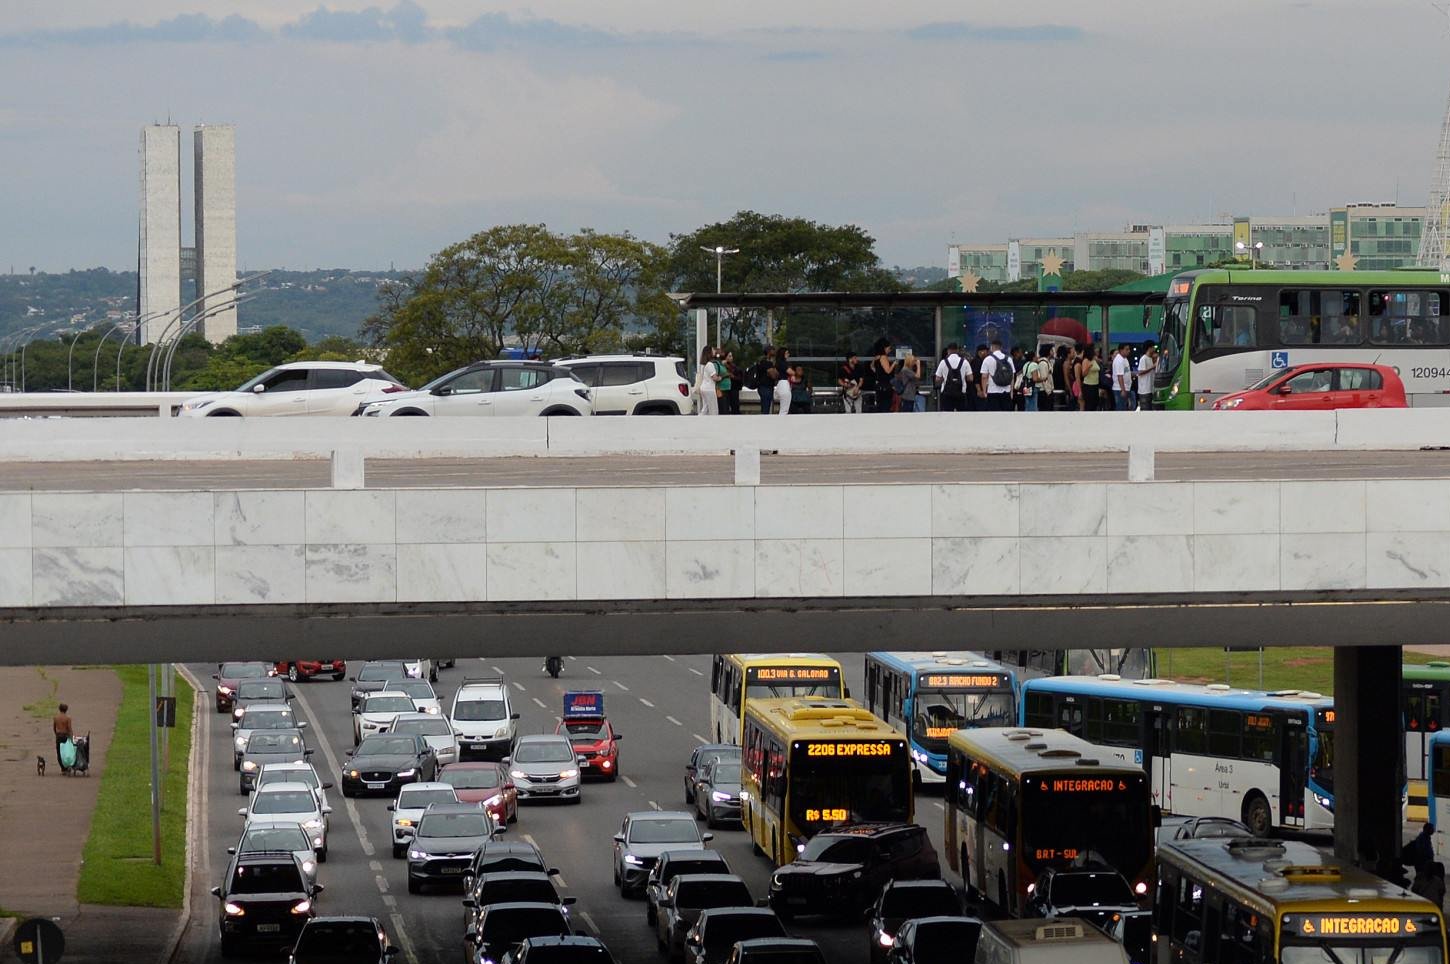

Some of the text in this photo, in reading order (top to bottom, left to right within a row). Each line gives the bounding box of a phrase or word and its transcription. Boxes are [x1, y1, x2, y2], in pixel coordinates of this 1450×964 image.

[992, 676, 998, 686] 2
[807, 743, 891, 756] 2206 EXPRESSA
